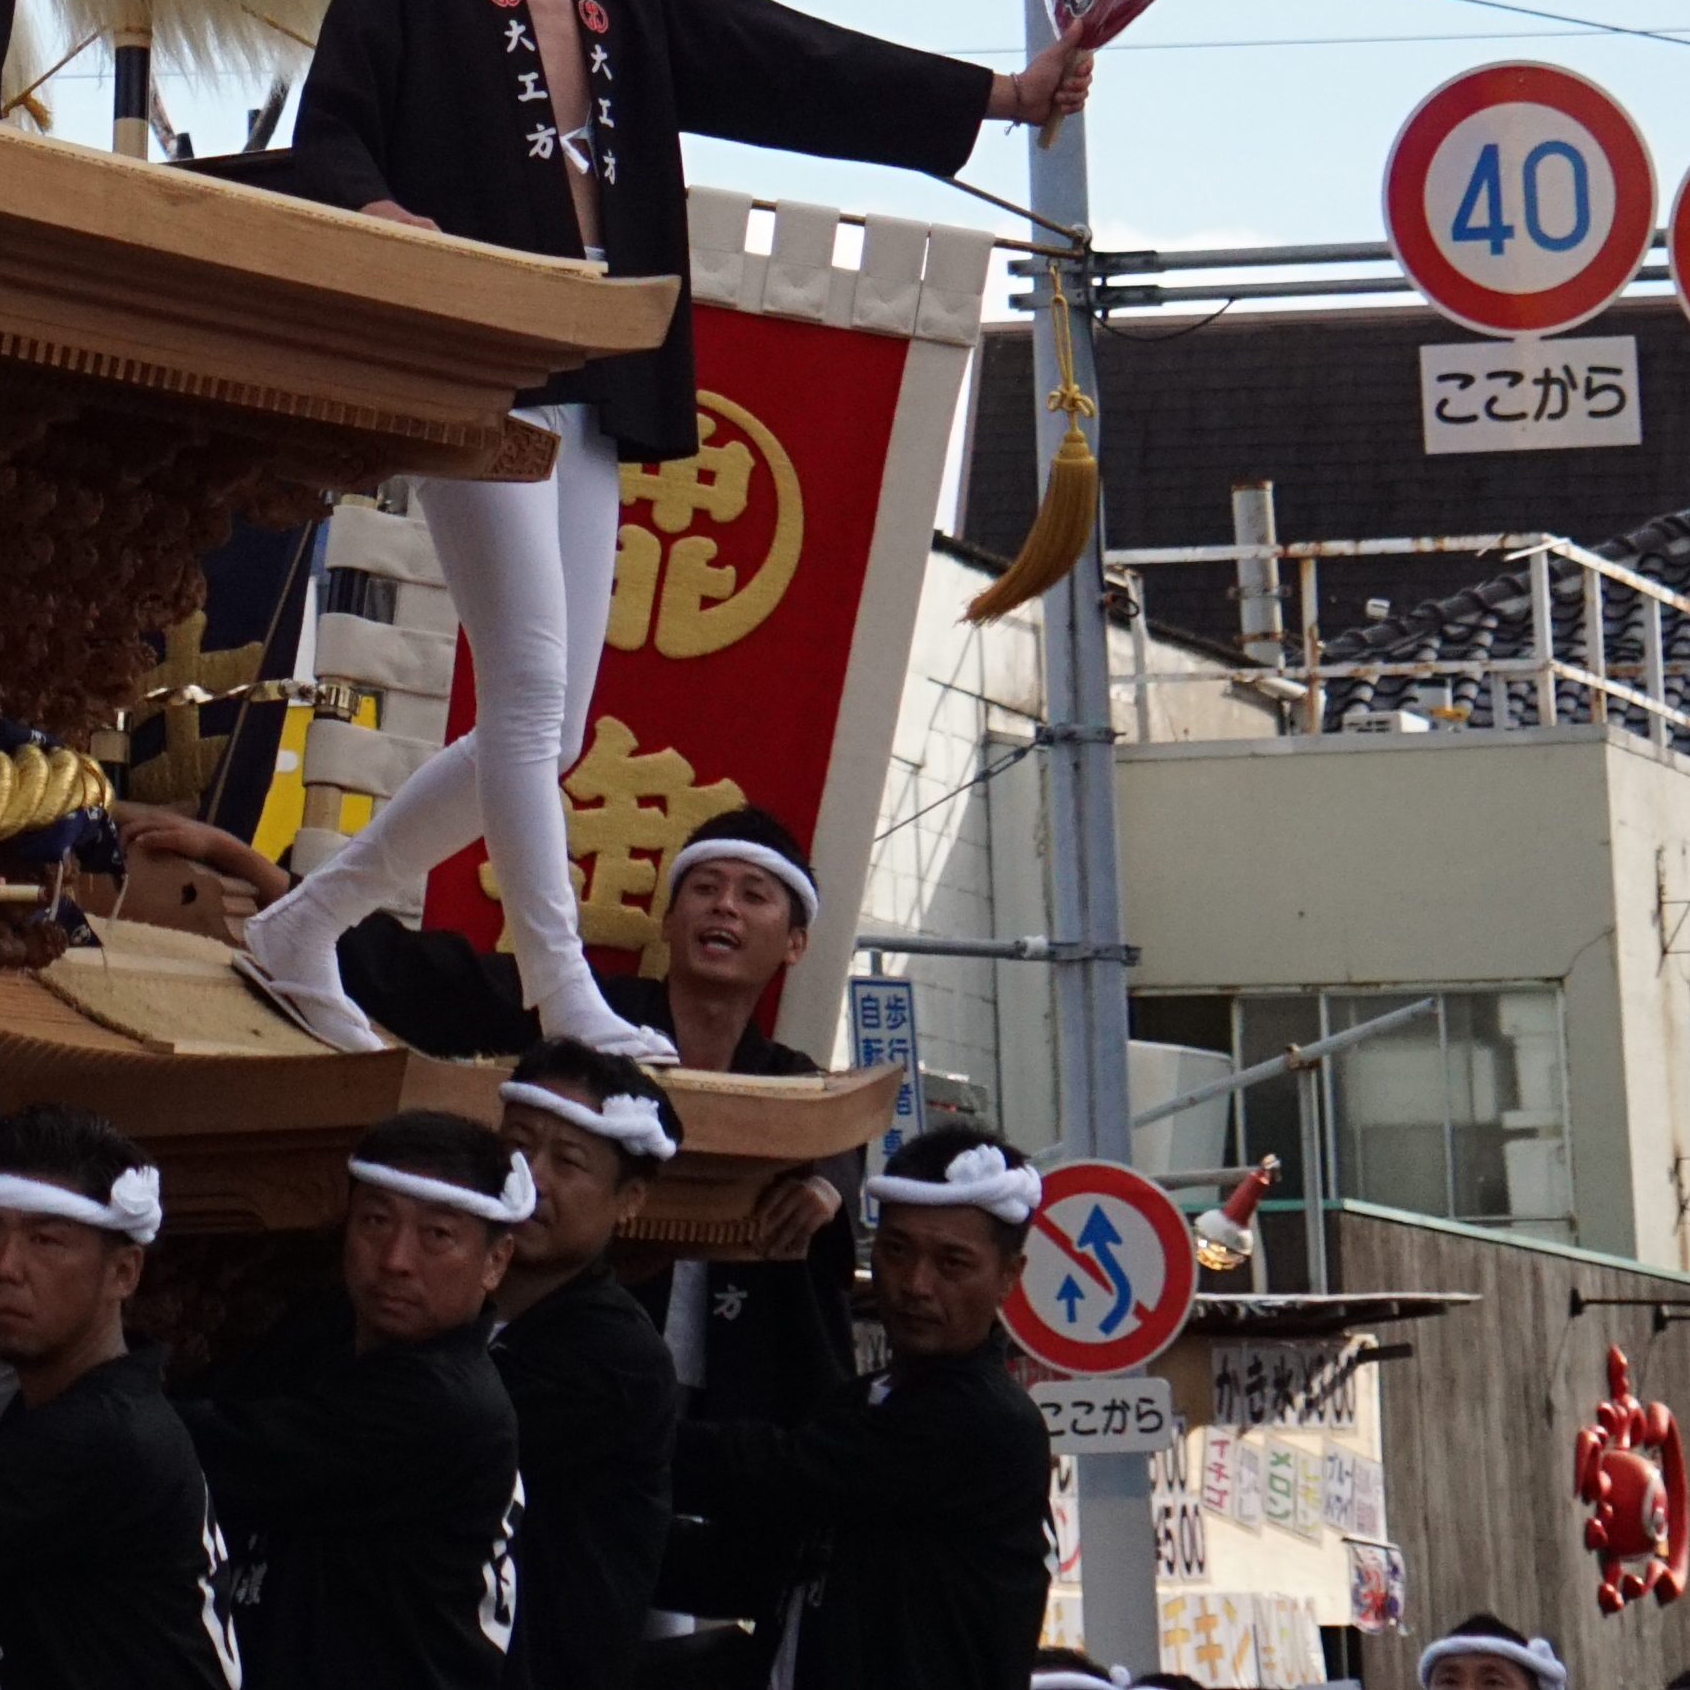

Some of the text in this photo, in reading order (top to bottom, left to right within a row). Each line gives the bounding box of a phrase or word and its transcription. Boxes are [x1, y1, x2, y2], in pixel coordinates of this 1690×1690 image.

[503, 19, 557, 160] 大工方
[590, 43, 617, 186] 大工方
[1450, 140, 1593, 256] 40
[1434, 364, 1628, 426] ここから
[1039, 1398, 1164, 1437] ここから
[1205, 1438, 1231, 1510] イチゴ
[1266, 1450, 1293, 1521] メロン
